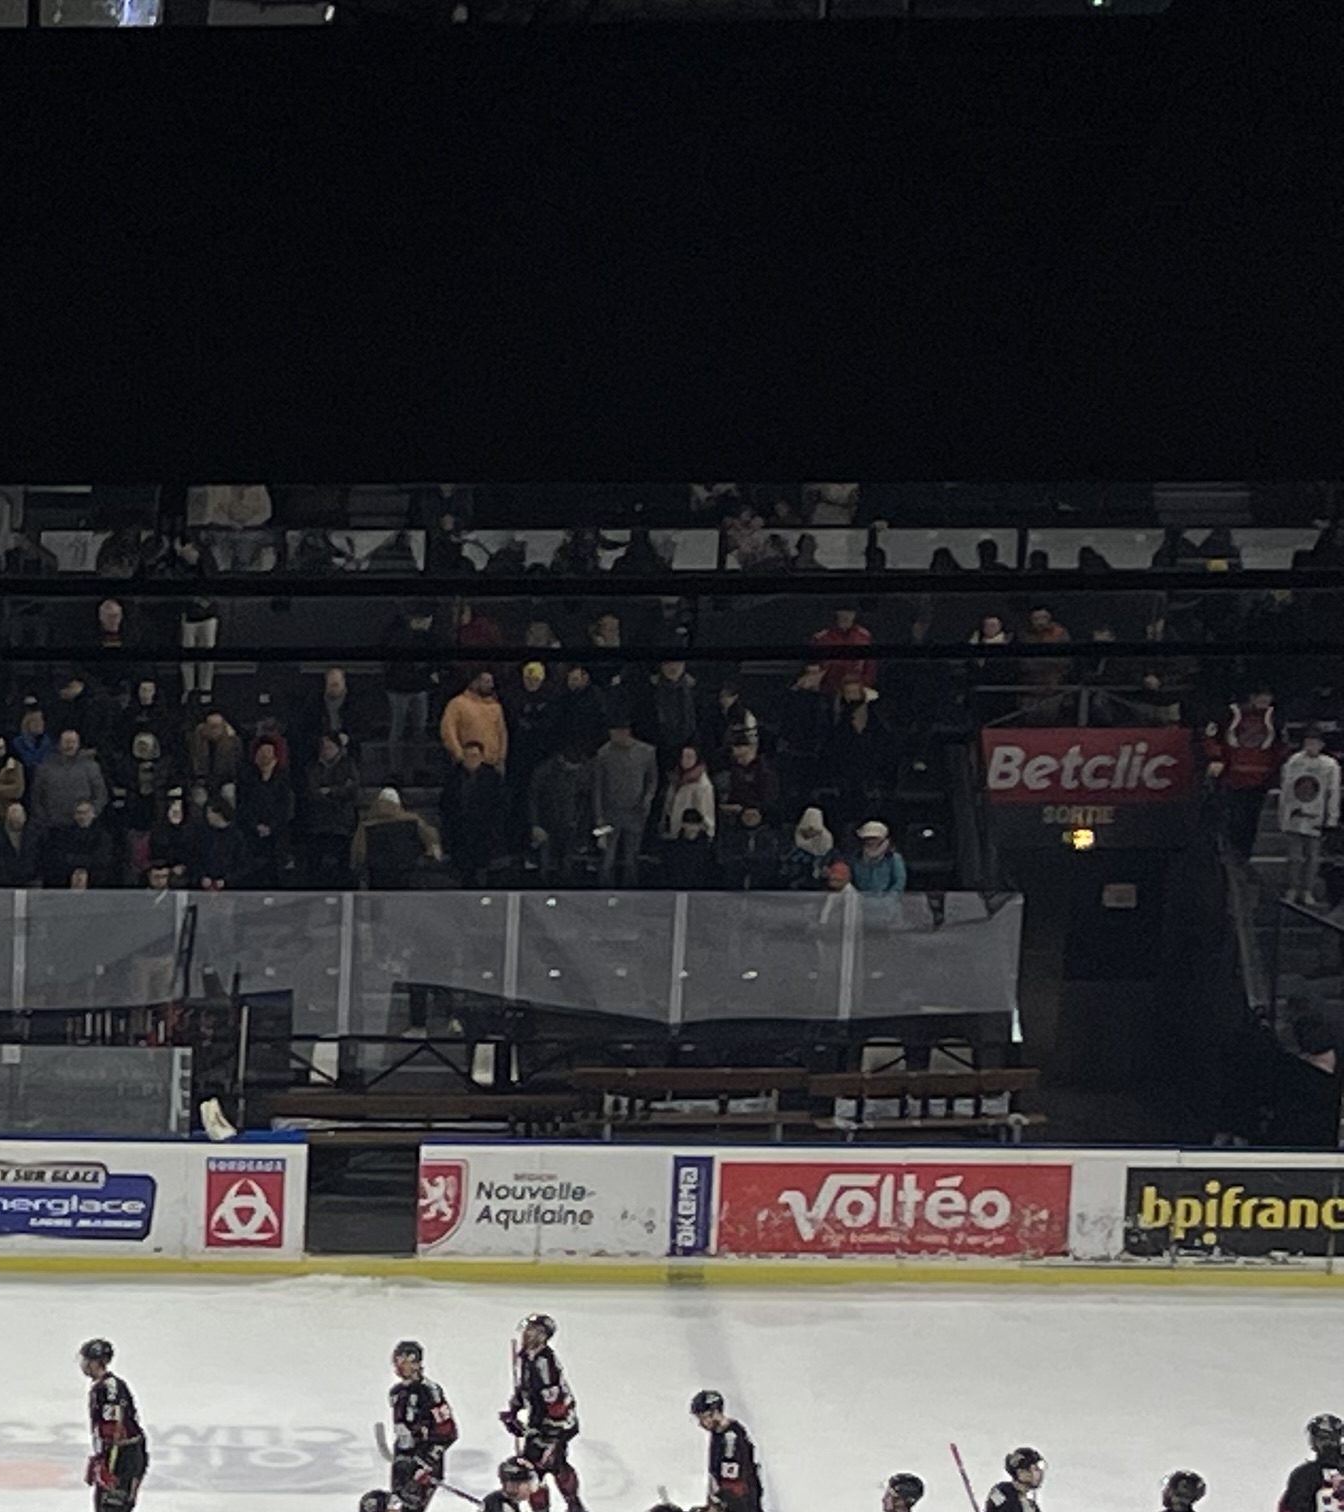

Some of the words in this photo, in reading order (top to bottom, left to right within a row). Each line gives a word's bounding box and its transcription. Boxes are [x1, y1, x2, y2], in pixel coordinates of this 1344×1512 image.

[987, 742, 1178, 790] Betclic
[1042, 805, 1116, 824] SORTIE
[13, 1168, 47, 1183] SUR
[50, 1169, 101, 1184] GLACE
[474, 1203, 595, 1231] Aquitaine
[777, 1172, 1012, 1242] Voltéo
